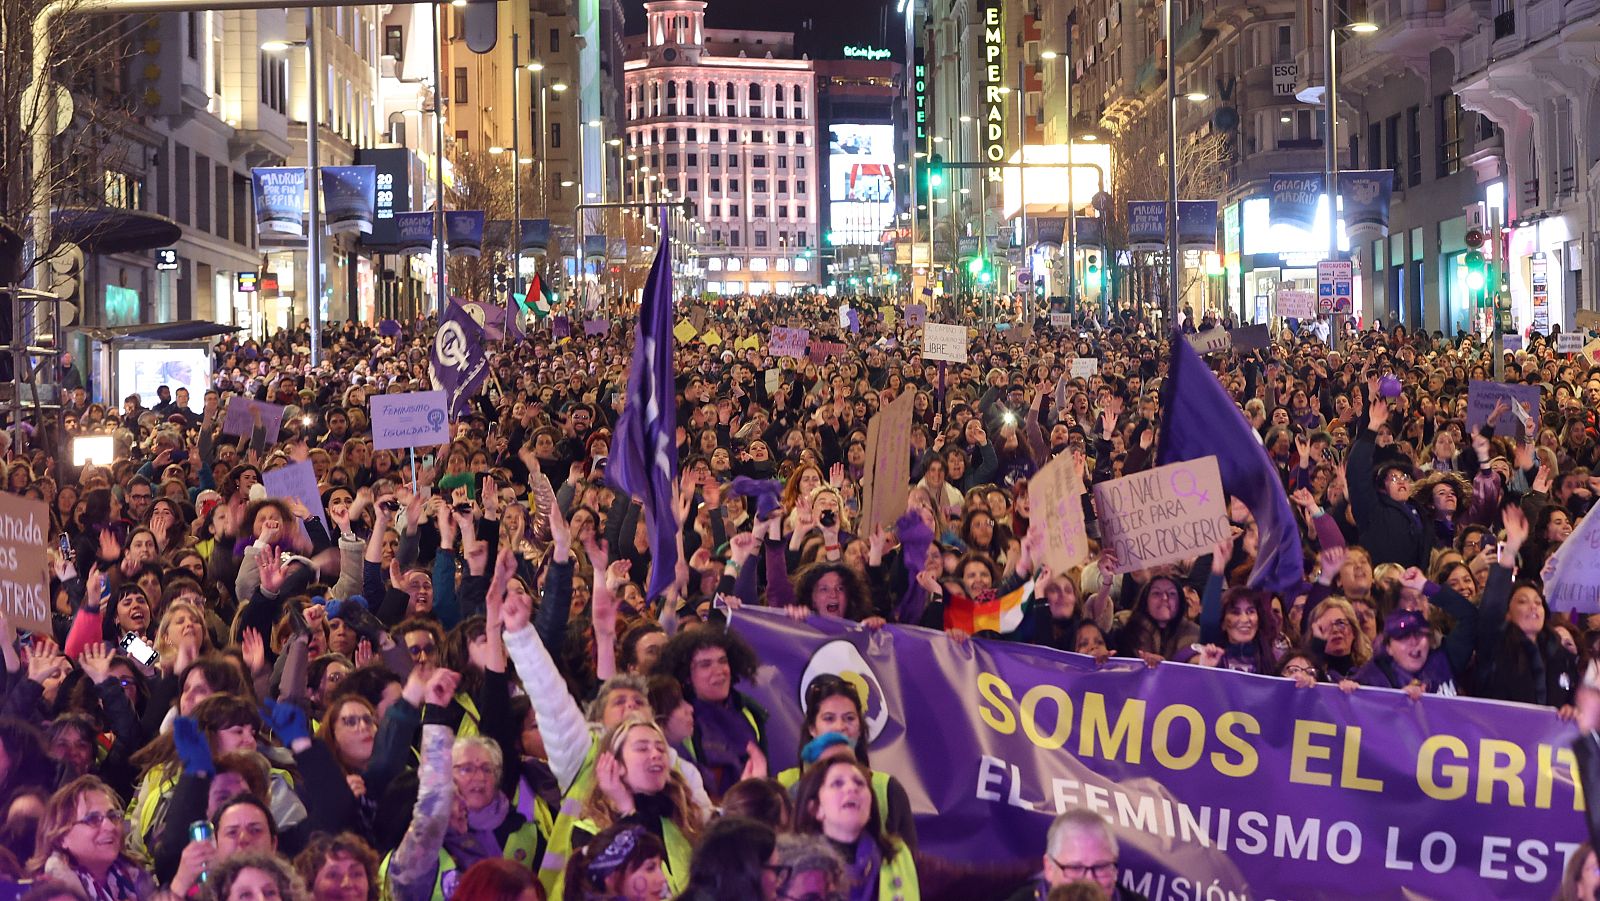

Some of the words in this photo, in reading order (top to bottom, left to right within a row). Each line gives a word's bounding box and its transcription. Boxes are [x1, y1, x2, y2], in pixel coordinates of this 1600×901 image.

[1274, 65, 1298, 76] ESC
[986, 8, 1003, 182] EMPERADOR
[915, 66, 925, 138] HOTEL
[261, 173, 304, 185] MADRID
[377, 174, 393, 184] 20
[264, 186, 280, 195] POR
[281, 185, 296, 194] FIN
[1273, 180, 1318, 192] GRACIAS
[258, 194, 301, 206] RESPIRA
[377, 191, 393, 201] 20
[1274, 191, 1315, 204] MADRID
[1134, 206, 1162, 215] MADRID
[1131, 223, 1163, 233] RESPIRA
[383, 404, 430, 415] FEMINISMO
[383, 425, 430, 437] IGUALDAD
[1099, 486, 1123, 515] NO
[1150, 499, 1187, 524] PARA
[0, 511, 43, 546] nada
[1114, 532, 1156, 568] ORIR
[0, 579, 46, 621] TRAS
[977, 671, 1261, 778] SOMOS
[1289, 719, 1384, 793] EL
[976, 754, 1034, 809] EL
[1051, 778, 1362, 865] FEMINISMO
[1385, 826, 1457, 874] LO
